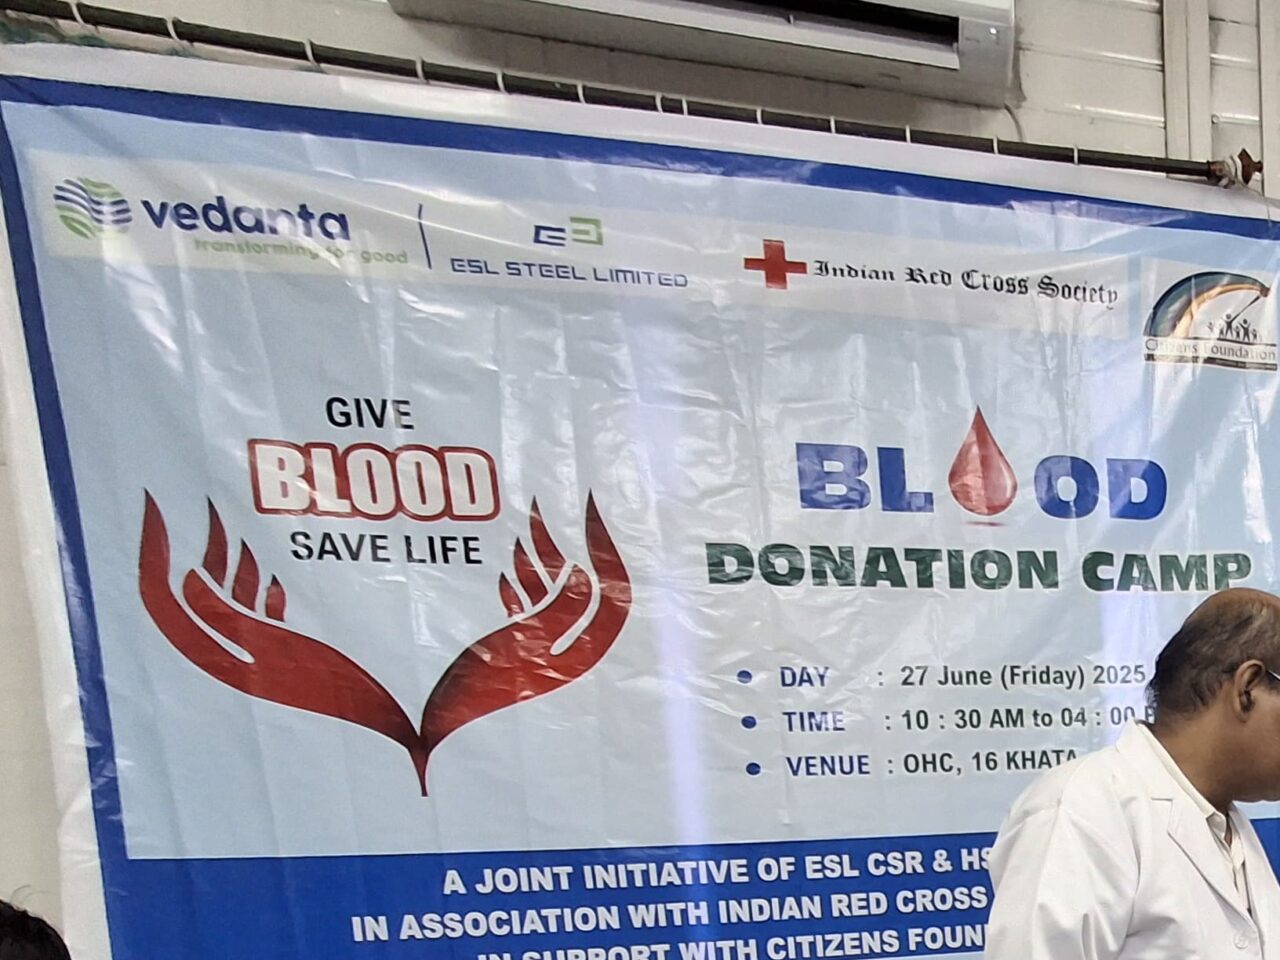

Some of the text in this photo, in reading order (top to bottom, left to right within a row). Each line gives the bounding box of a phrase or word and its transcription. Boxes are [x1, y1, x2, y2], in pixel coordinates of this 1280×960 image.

[141, 196, 350, 240] vedanta
[360, 250, 408, 264] good
[450, 257, 688, 287] ESL STEEL LIMITED
[813, 259, 1118, 310] Indian Red Cross Society
[326, 397, 414, 430] GIVE
[248, 438, 500, 521] BLOOD
[290, 532, 483, 565] SAVE LIFE
[705, 542, 1252, 592] DONATION CAMP
[780, 667, 829, 687] DAY
[901, 666, 927, 686] 27
[937, 666, 992, 686] June
[1001, 664, 1085, 690] (Friday)
[1093, 665, 1146, 684] 2025
[783, 711, 846, 732] TIME
[902, 711, 929, 730] 10
[955, 710, 981, 729] 30
[990, 709, 1024, 728] AM
[1032, 709, 1052, 728] to
[1061, 707, 1087, 726] 04
[787, 755, 870, 777] VENUE
[903, 752, 962, 776] OHC,
[972, 751, 998, 771] 16
[443, 870, 465, 895] A
[475, 865, 572, 894] JOINT
[584, 857, 748, 889] INITIATIVE
[758, 856, 795, 881] OF
[805, 854, 859, 878] ESL
[867, 851, 925, 876] CSR
[932, 849, 953, 872] &
[351, 886, 988, 942] IN ASSOCIATION WITH INDIAN RED CROSS
[767, 930, 900, 960] CITIZENS
[907, 924, 987, 950] FOUN
